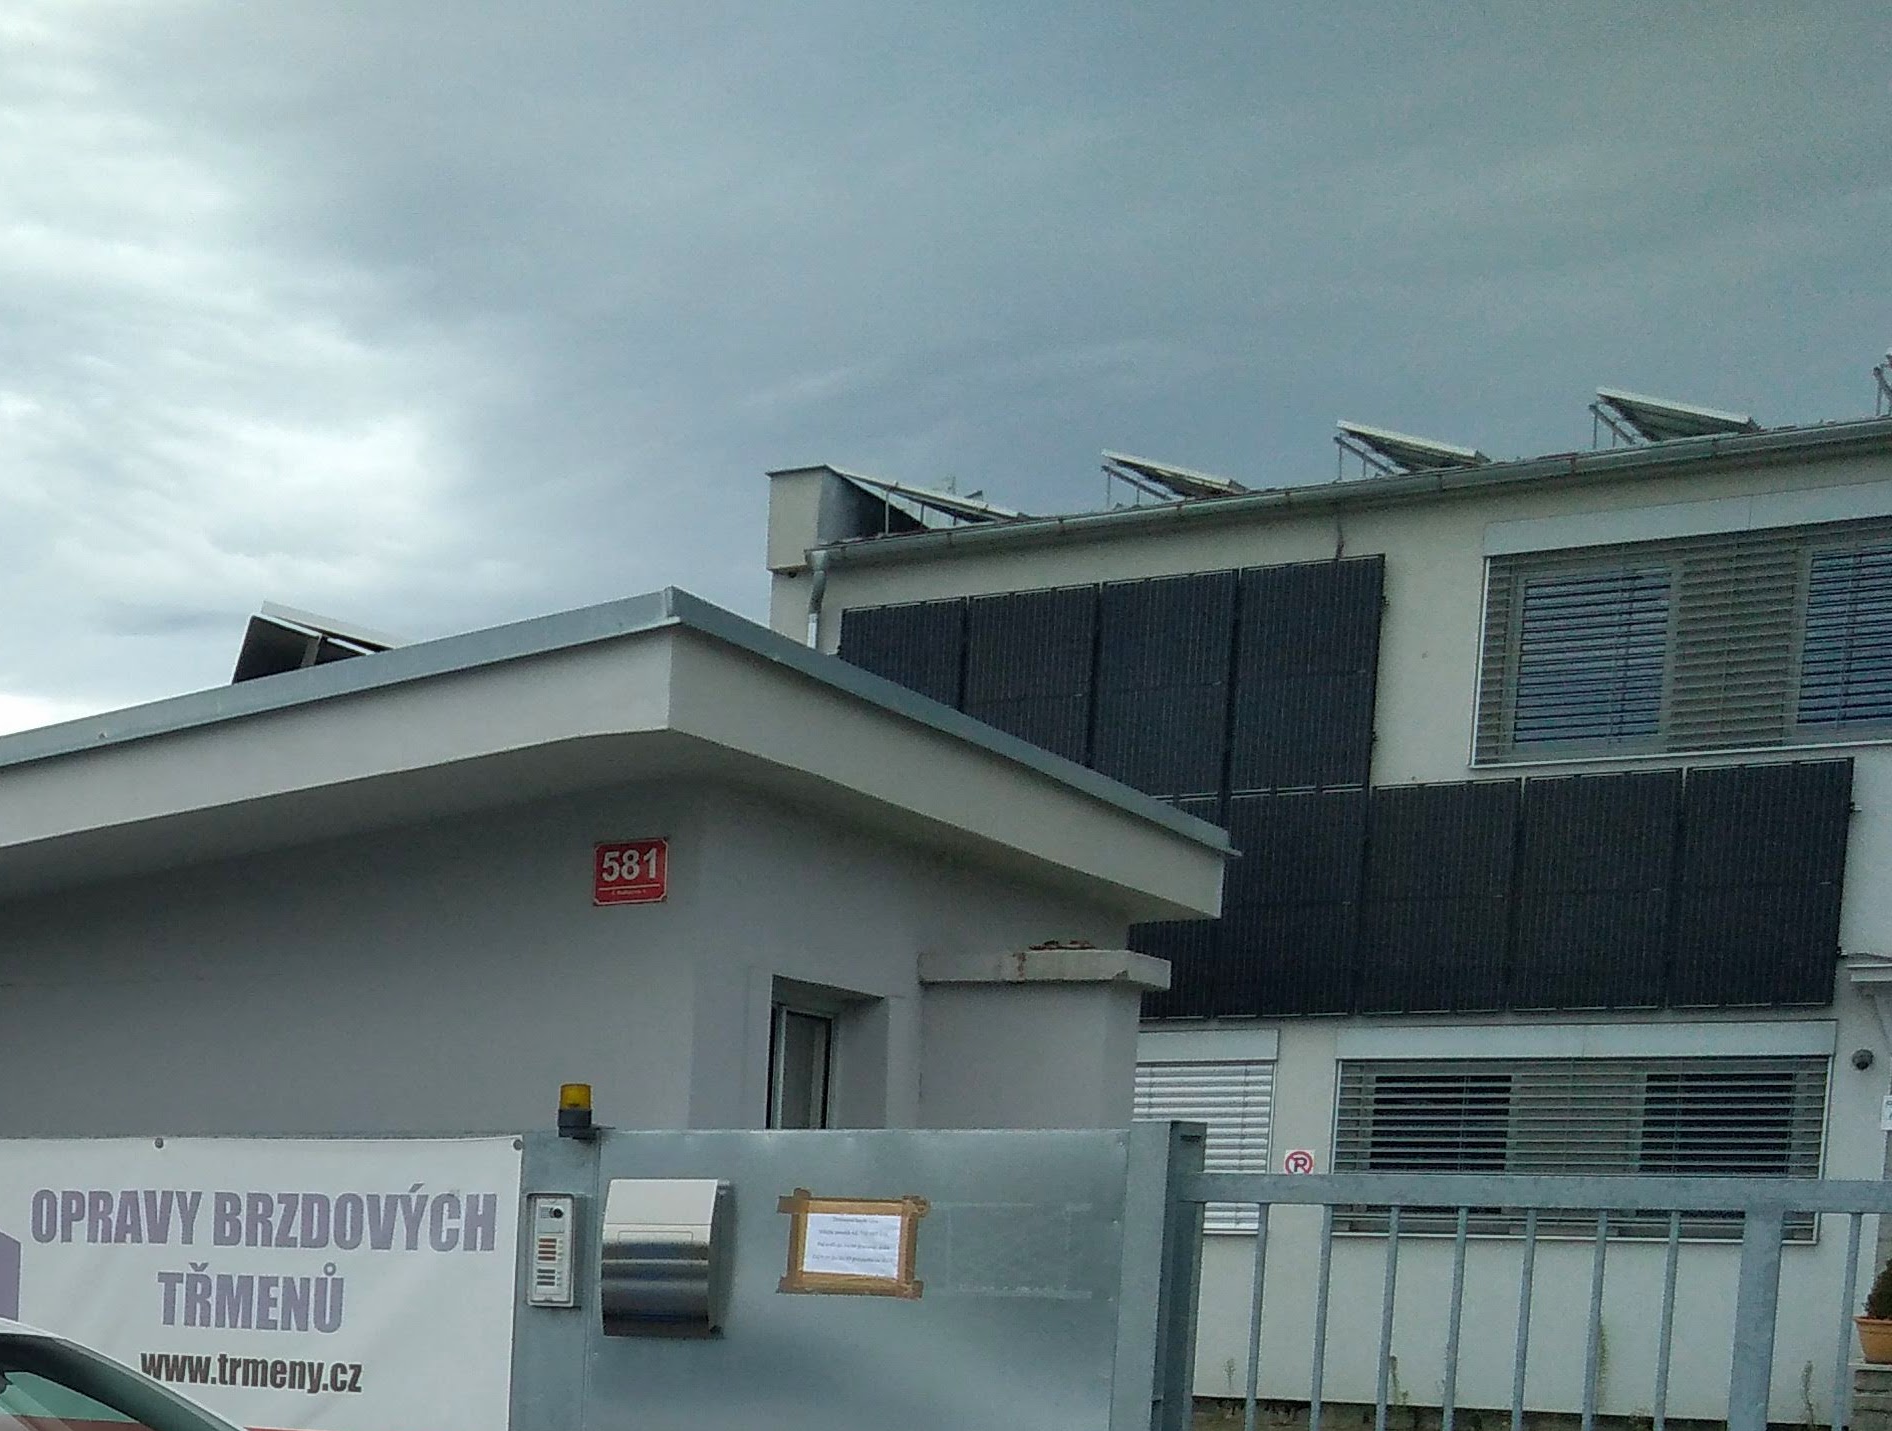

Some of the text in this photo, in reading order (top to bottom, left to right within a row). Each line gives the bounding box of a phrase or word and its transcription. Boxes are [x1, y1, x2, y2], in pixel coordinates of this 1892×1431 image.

[601, 847, 658, 882] 581
[30, 1182, 498, 1253] OPRAVY BRZDOVÝCH
[157, 1262, 346, 1334] TŘMENŮ
[140, 1352, 364, 1394] www.trmeny.cz
